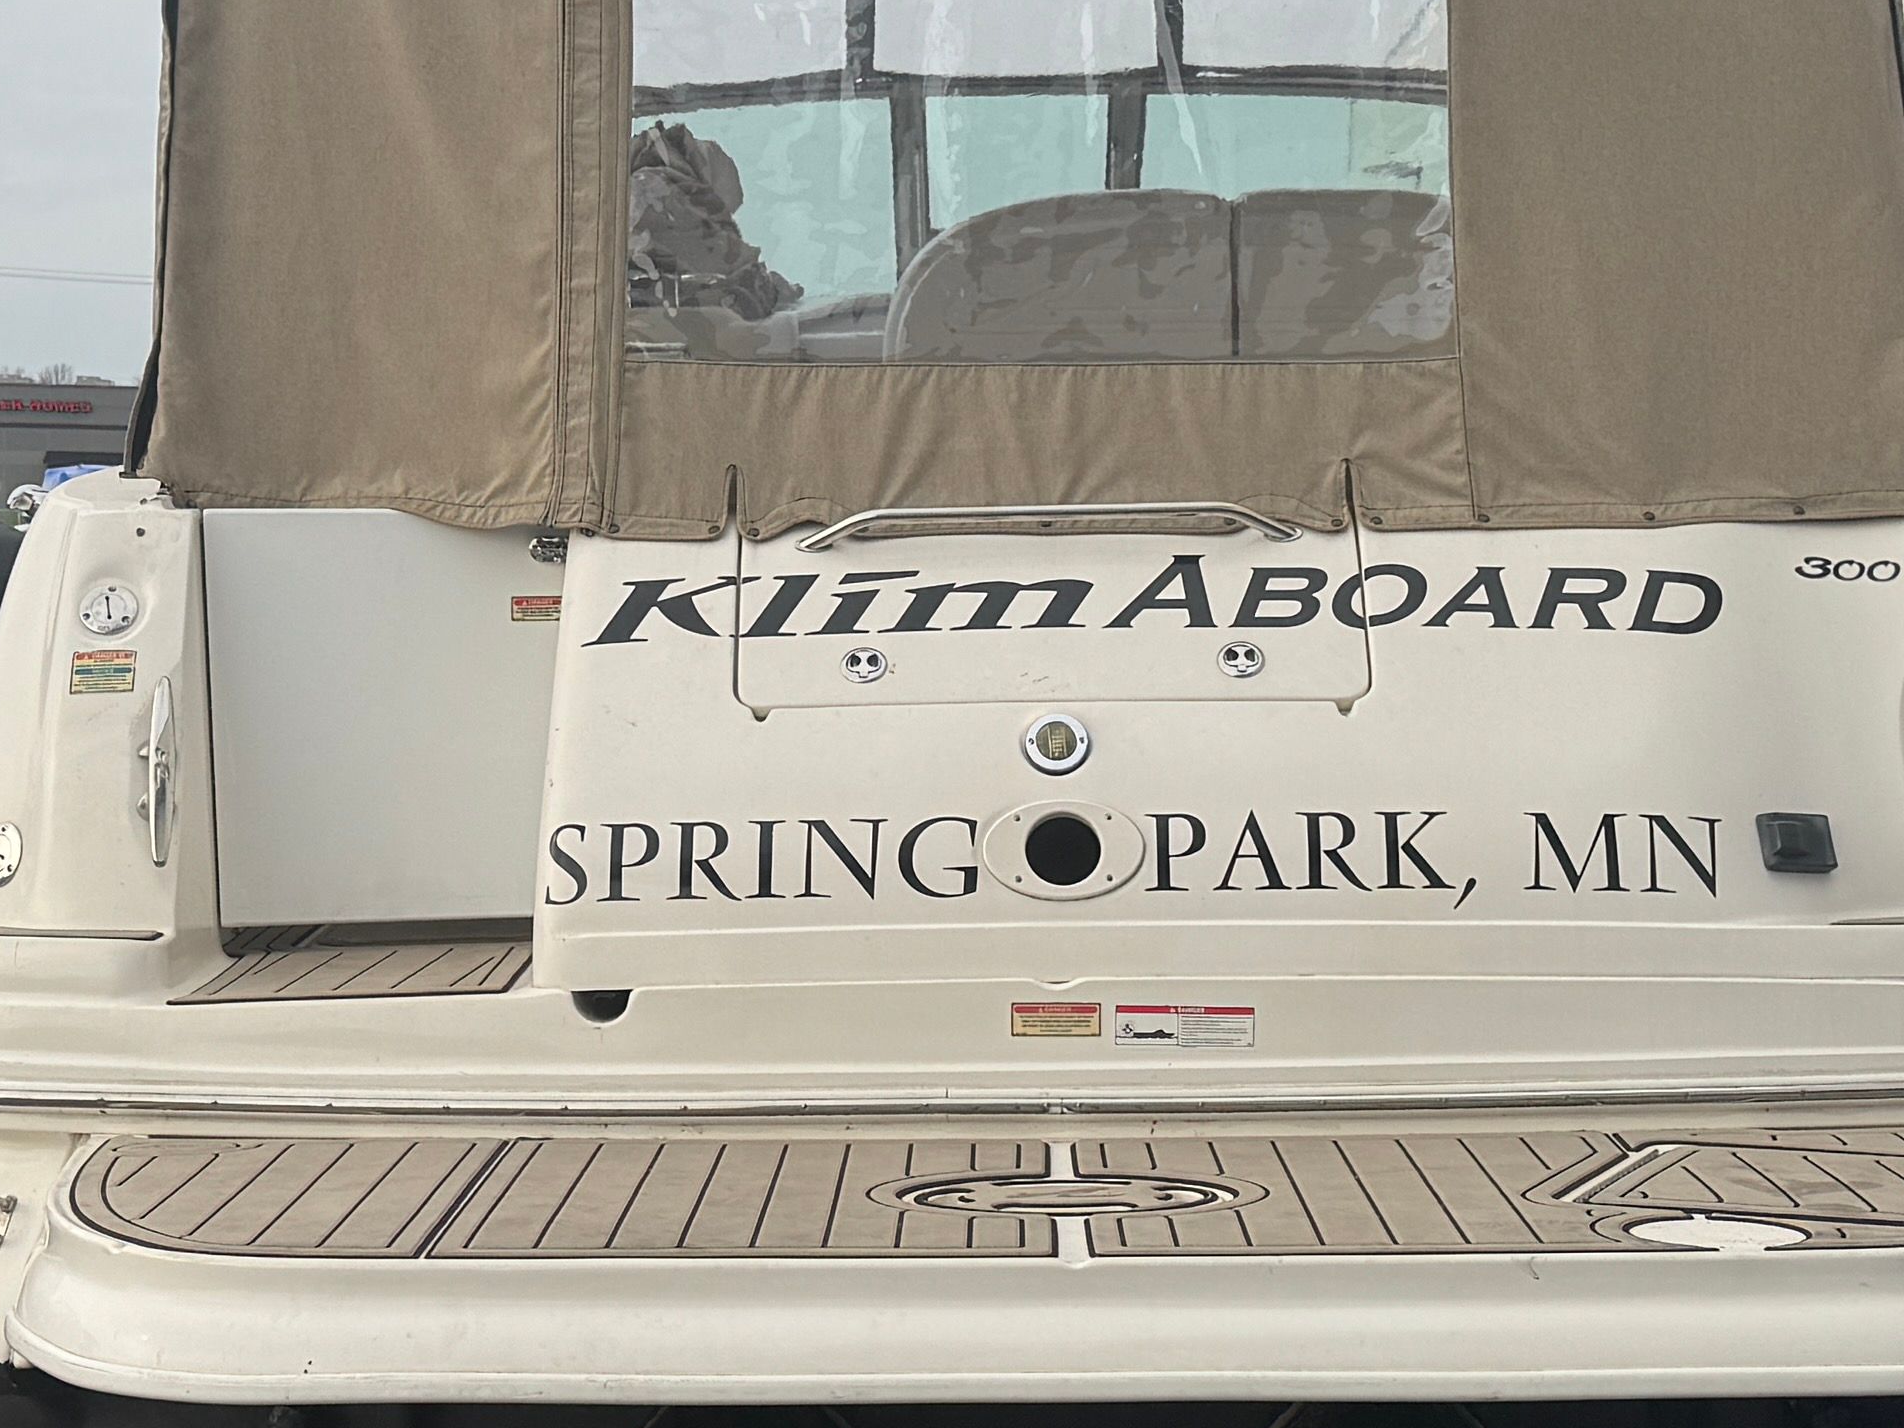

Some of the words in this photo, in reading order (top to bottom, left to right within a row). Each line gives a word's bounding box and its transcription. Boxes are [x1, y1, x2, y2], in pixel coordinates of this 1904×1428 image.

[1794, 556, 1901, 582] 300
[544, 816, 979, 906] SPRING
[1145, 809, 1478, 910] PARK,
[1524, 812, 1722, 898] MN
